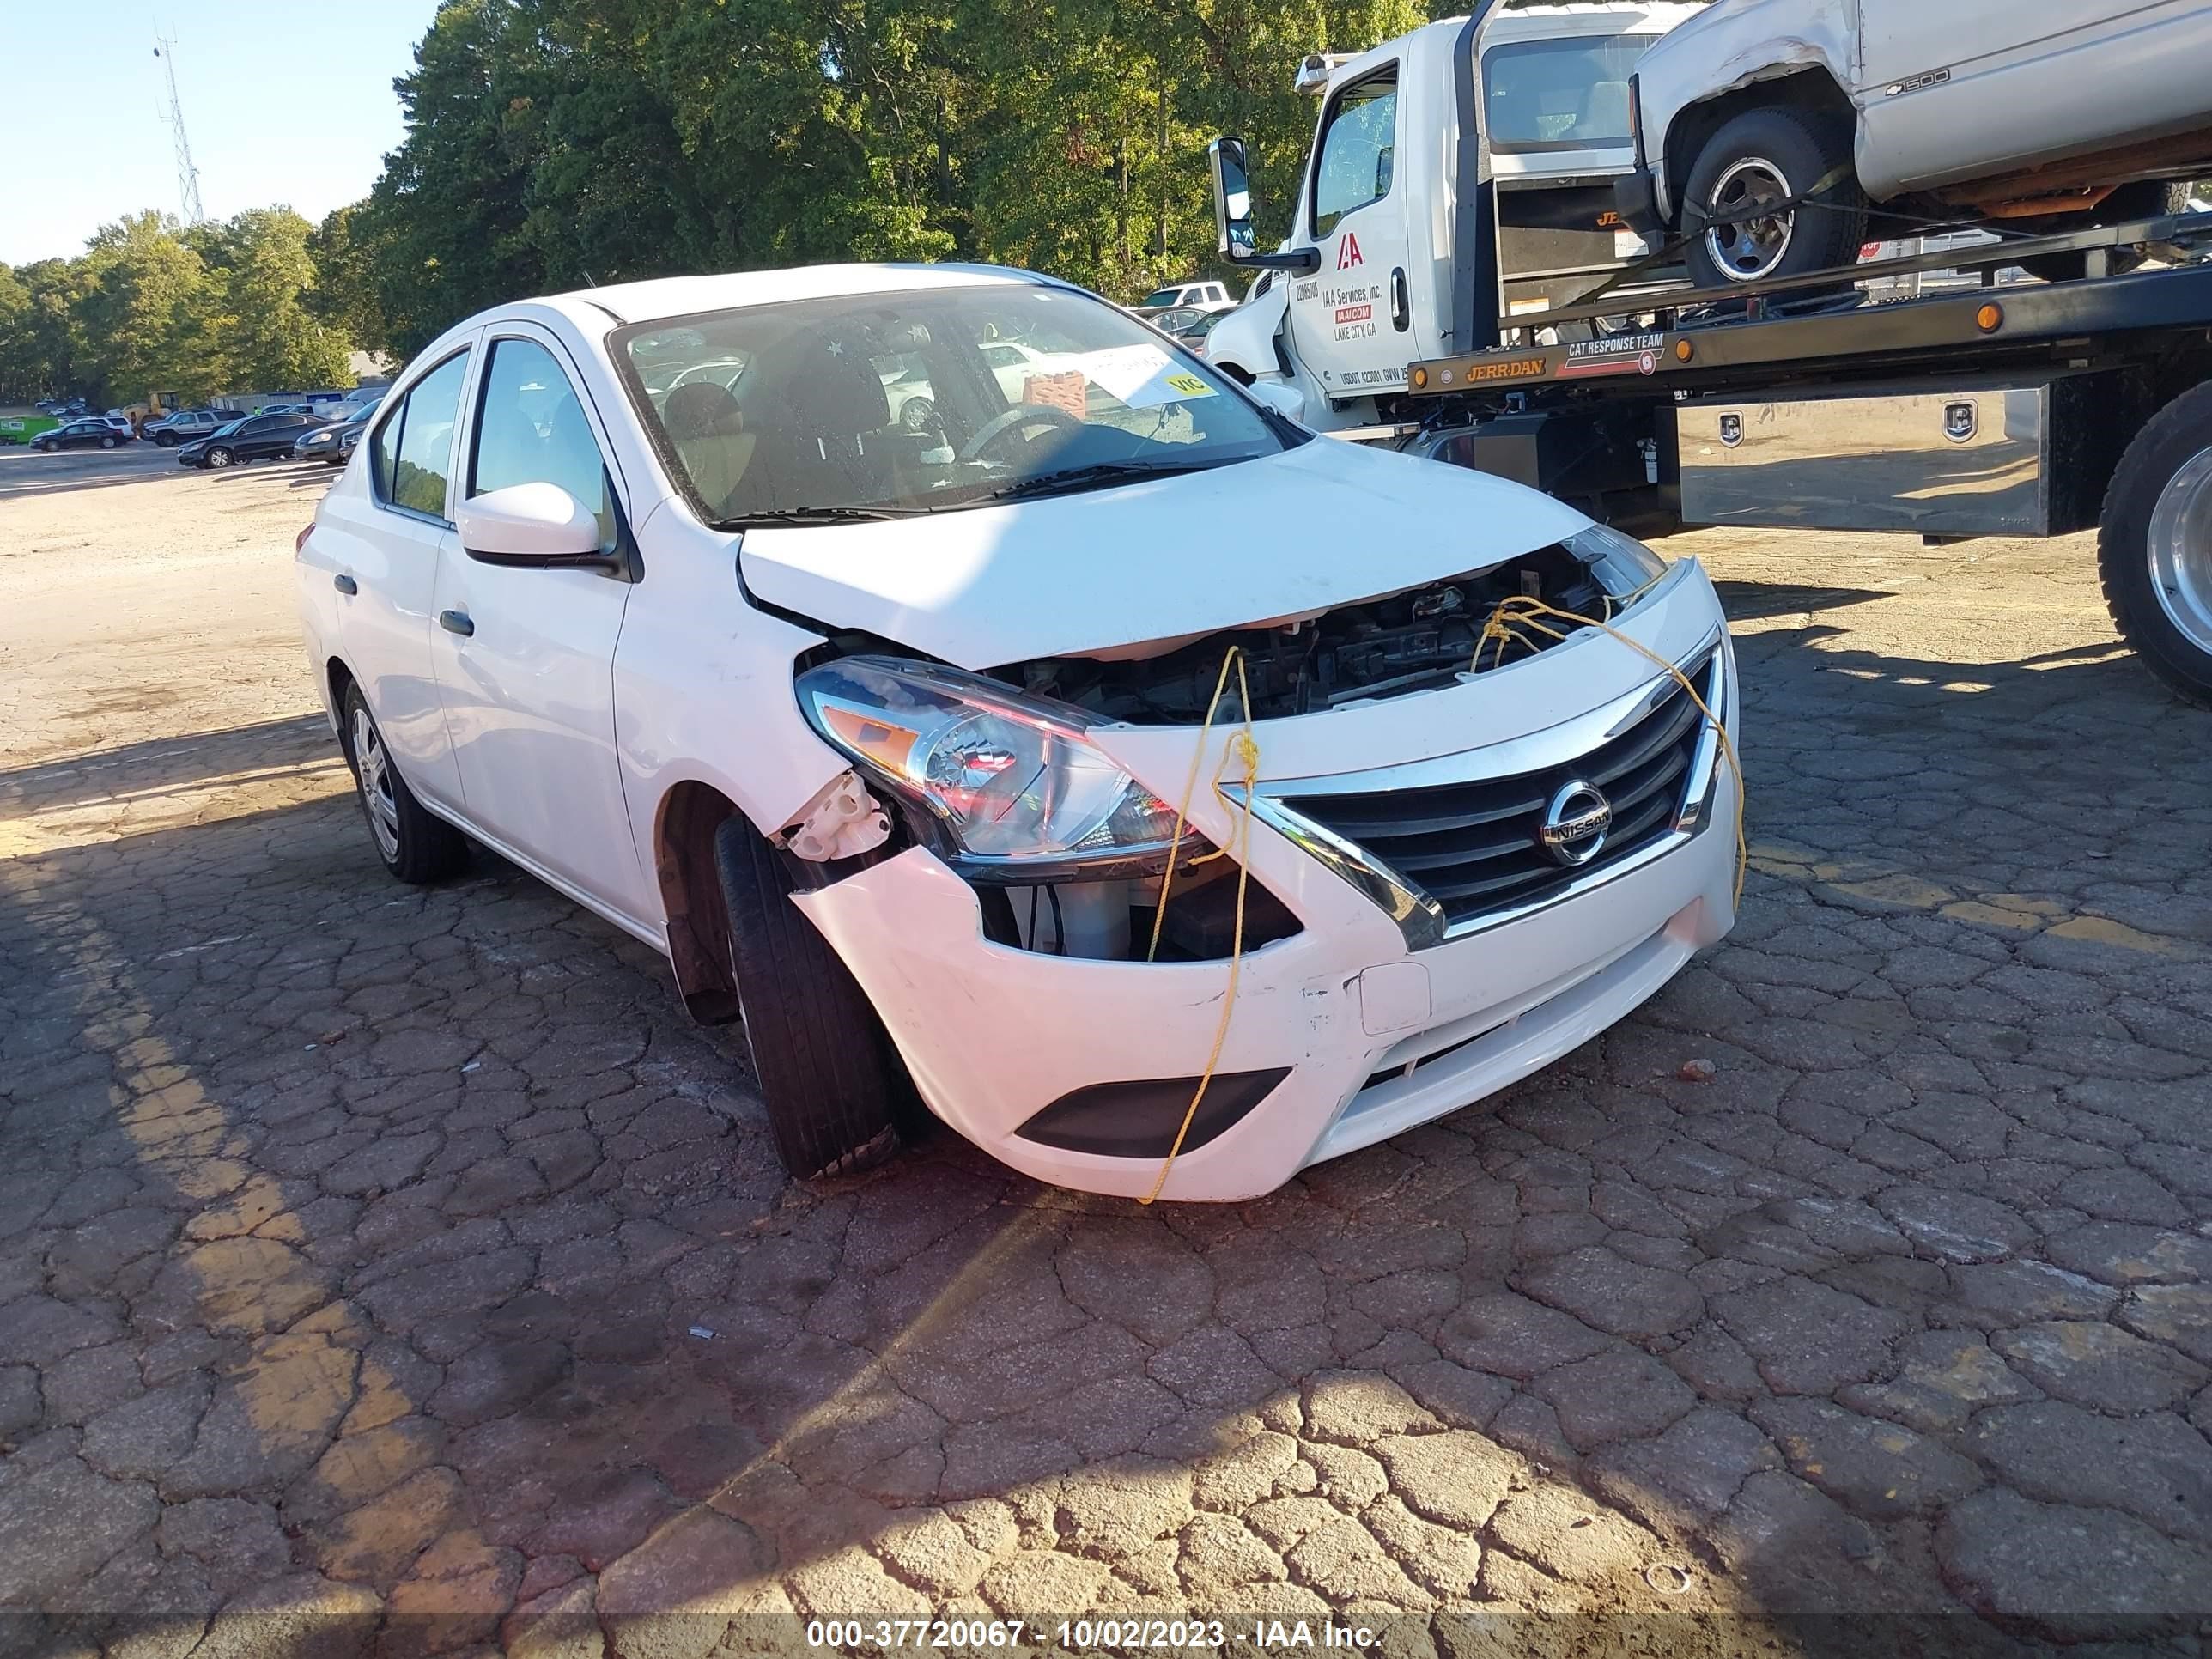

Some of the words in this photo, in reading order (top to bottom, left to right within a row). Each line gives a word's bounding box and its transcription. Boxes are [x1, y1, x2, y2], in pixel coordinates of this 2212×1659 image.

[1903, 70, 1948, 92] 1500
[1322, 289, 1336, 309] IAA
[1336, 284, 1369, 306] Services,
[1369, 282, 1382, 301] Inc.
[1337, 306, 1370, 324] IAAI.COM
[1334, 325, 1350, 342] LAKE
[1350, 324, 1367, 340] CITY,
[1366, 322, 1377, 337] GA
[1569, 342, 1588, 357] CAT
[1588, 336, 1636, 356] RESPONSE
[1636, 333, 1664, 349] TEAM
[1168, 378, 1206, 392] VIC
[1340, 371, 1361, 386] USDOT
[1382, 367, 1400, 381] GVW
[1557, 811, 1610, 841] NISSAN
